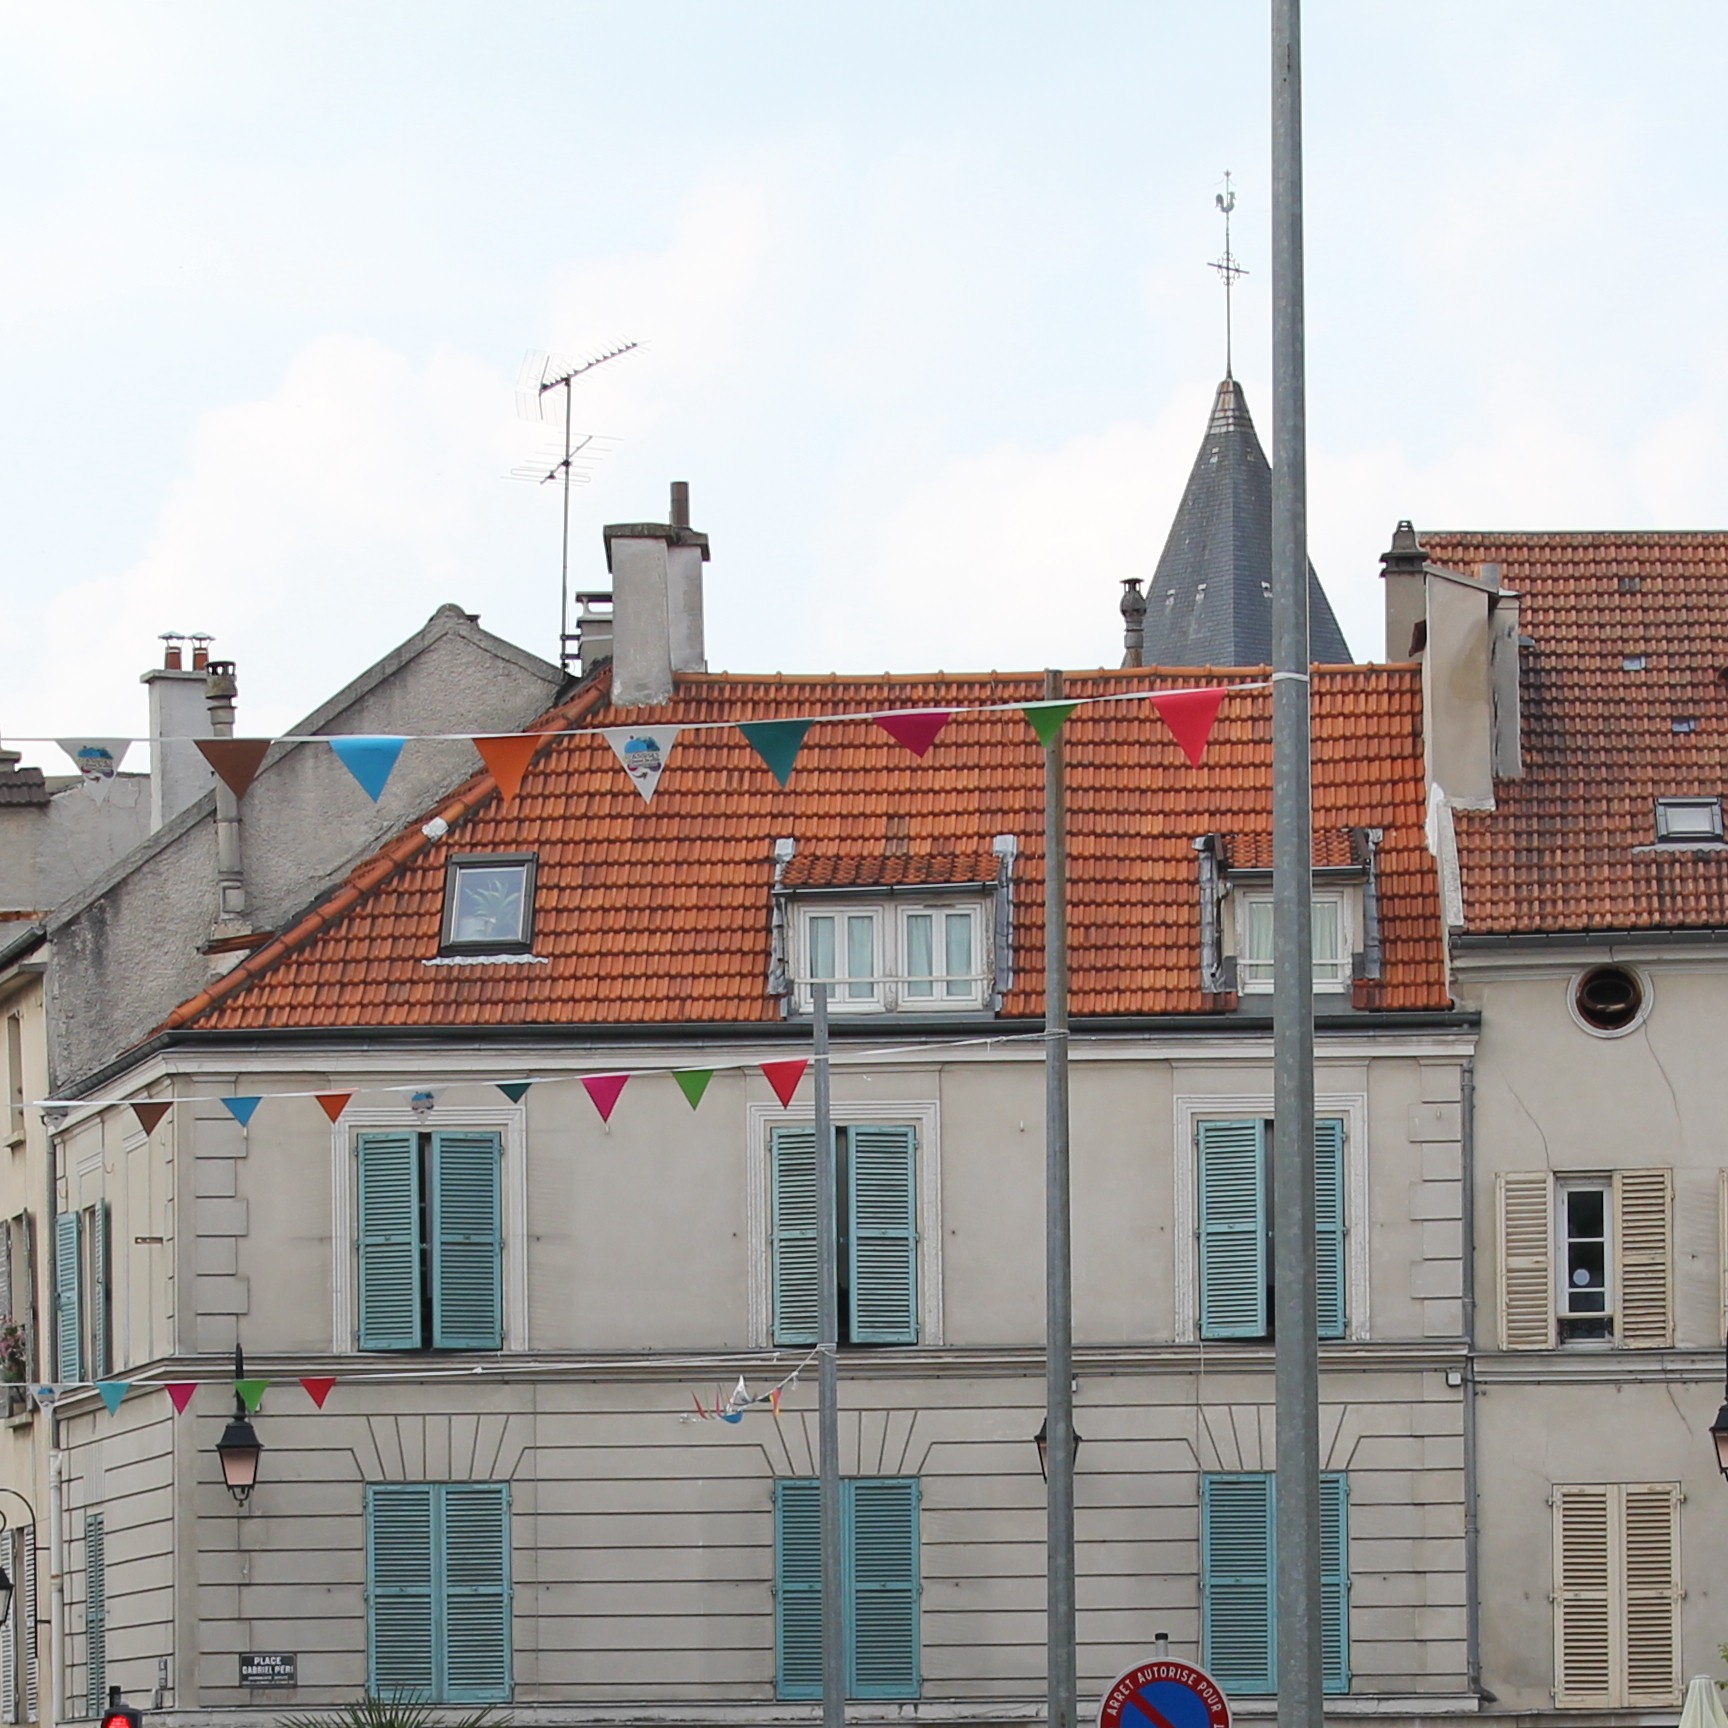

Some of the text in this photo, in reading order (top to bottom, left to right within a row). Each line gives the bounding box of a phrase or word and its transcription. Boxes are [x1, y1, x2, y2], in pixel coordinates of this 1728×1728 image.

[254, 1656, 282, 1665] PLACE
[242, 1665, 272, 1675] GABRIEL
[1106, 1666, 1222, 1716] ARRET AUTORISE POUR
